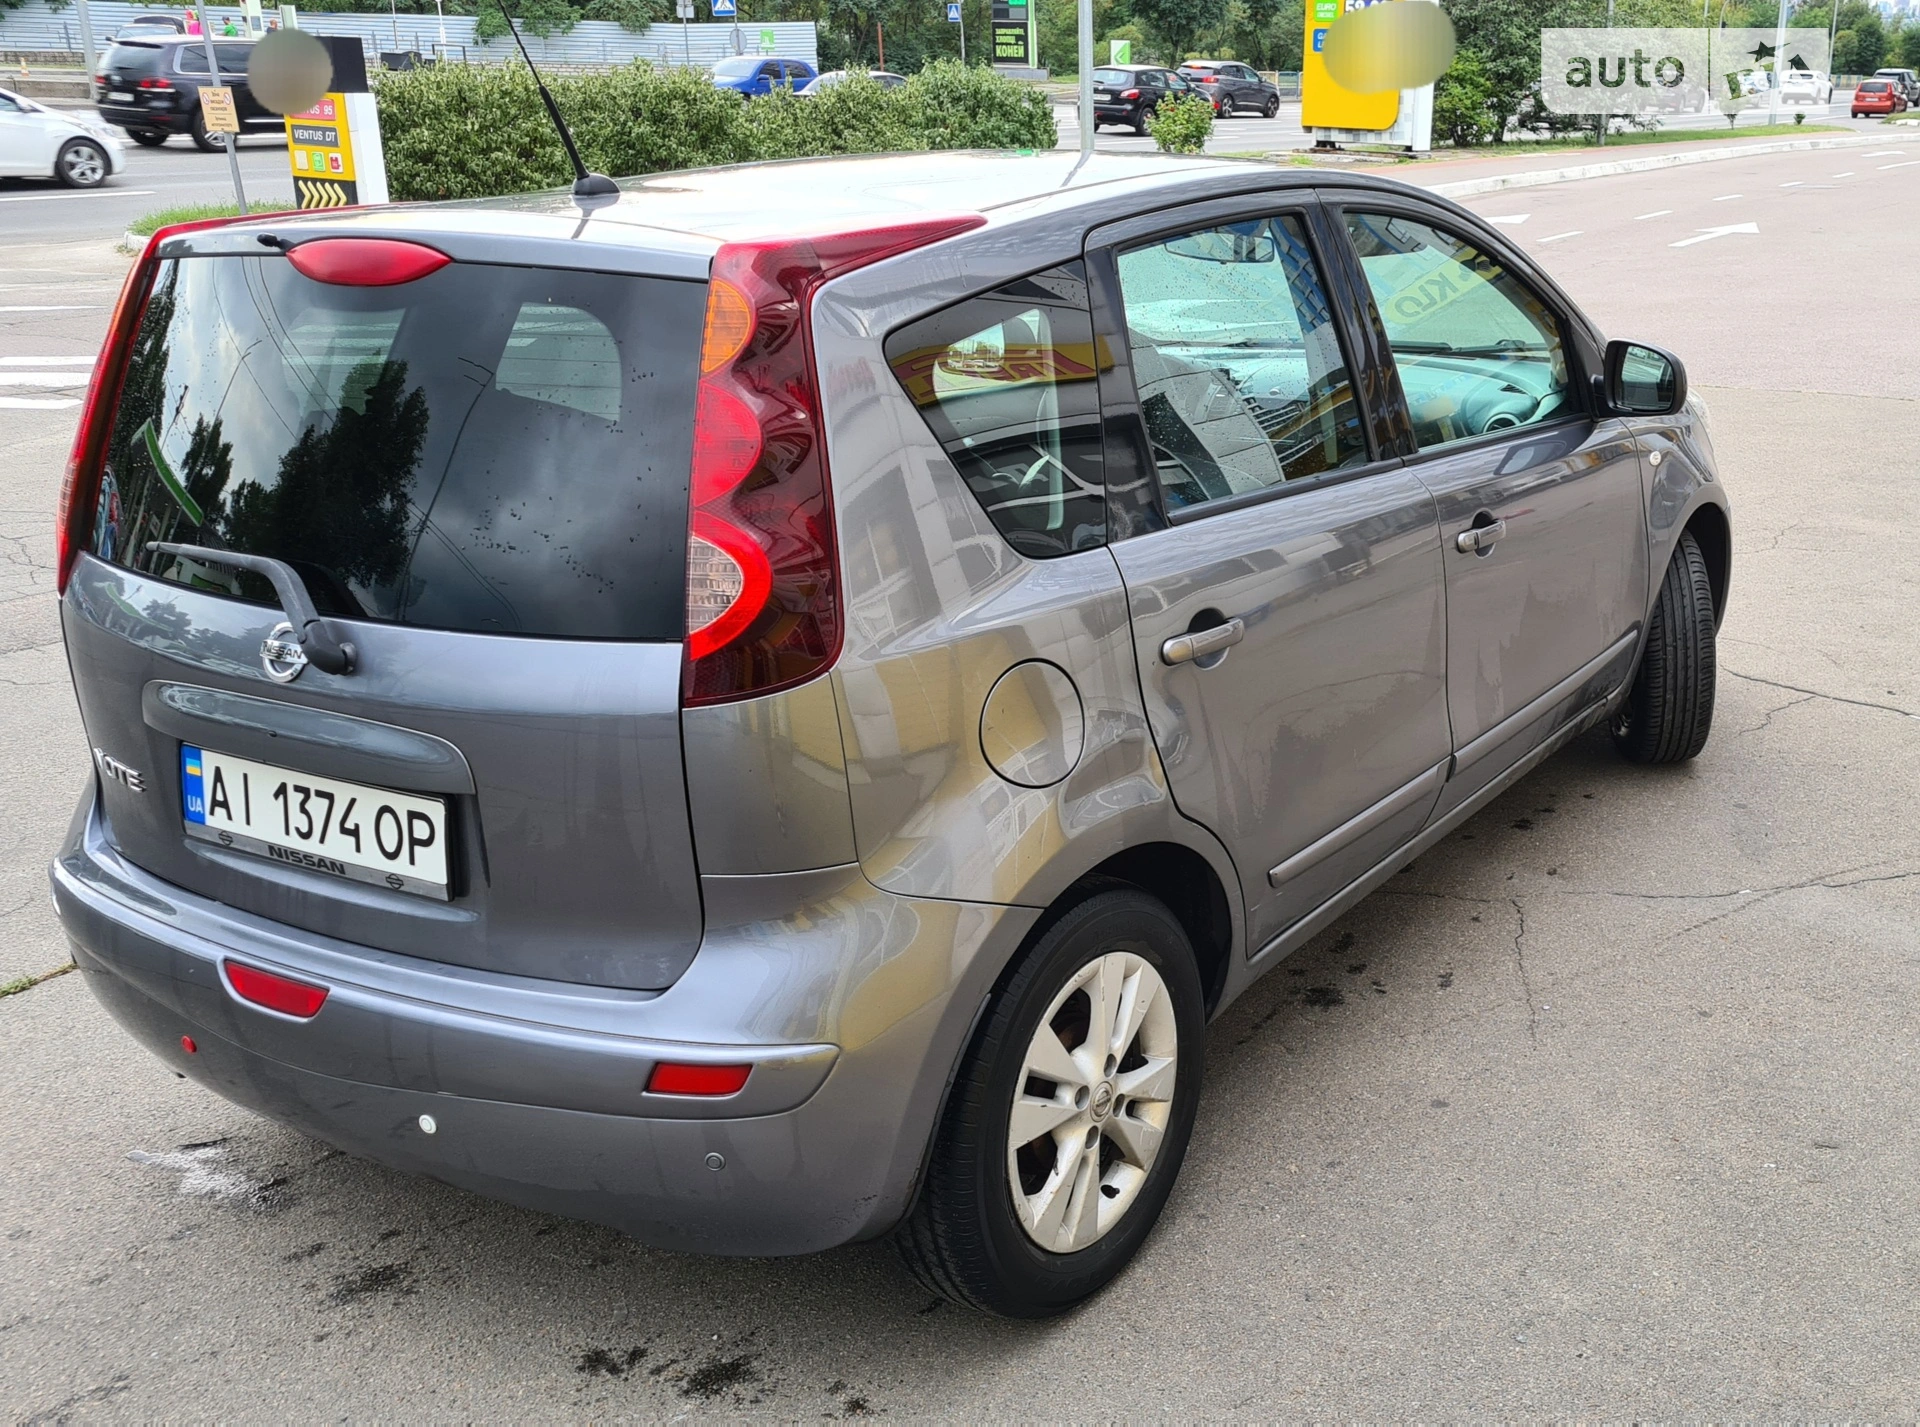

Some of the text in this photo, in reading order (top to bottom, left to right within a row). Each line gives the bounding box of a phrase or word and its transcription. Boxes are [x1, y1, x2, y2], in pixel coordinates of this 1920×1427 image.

[1316, 2, 1337, 11] EURO
[293, 128, 336, 142] VENTUS DT
[262, 640, 304, 660] NISSAN
[187, 795, 204, 814] UA
[208, 765, 436, 866] AI 1374 OP
[268, 844, 346, 875] NISSAN
